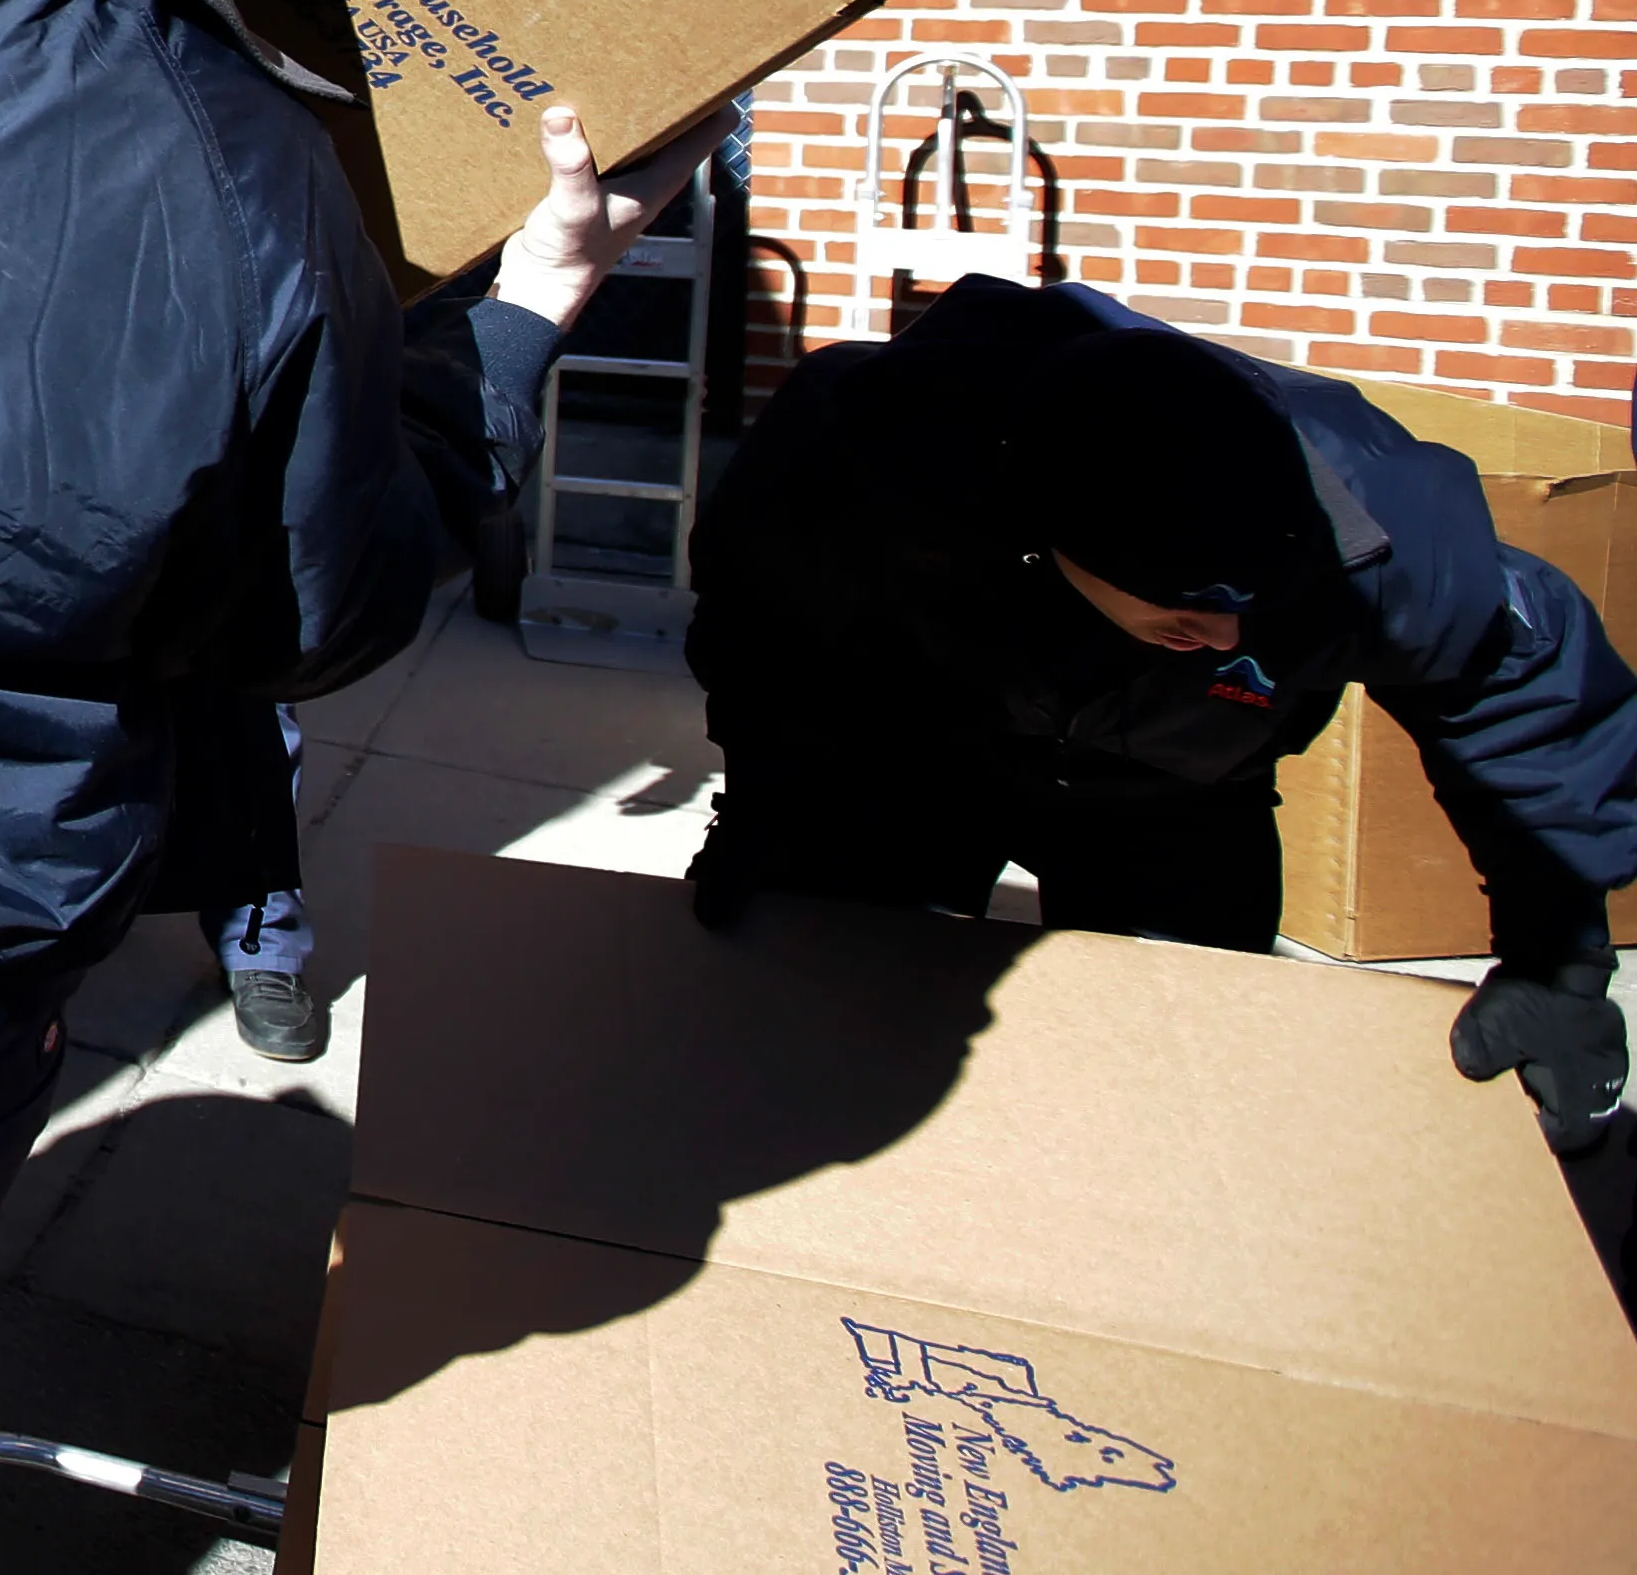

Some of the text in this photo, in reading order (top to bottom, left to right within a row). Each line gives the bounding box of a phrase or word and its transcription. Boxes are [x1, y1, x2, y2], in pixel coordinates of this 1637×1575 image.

[358, 19, 410, 67] USA
[449, 65, 522, 128] Inc.
[902, 1411, 953, 1508] Moving
[951, 1421, 1018, 1575] New Englan
[825, 1460, 880, 1575] 888-666-
[870, 1473, 906, 1557] Holliston
[920, 1508, 969, 1566] and
